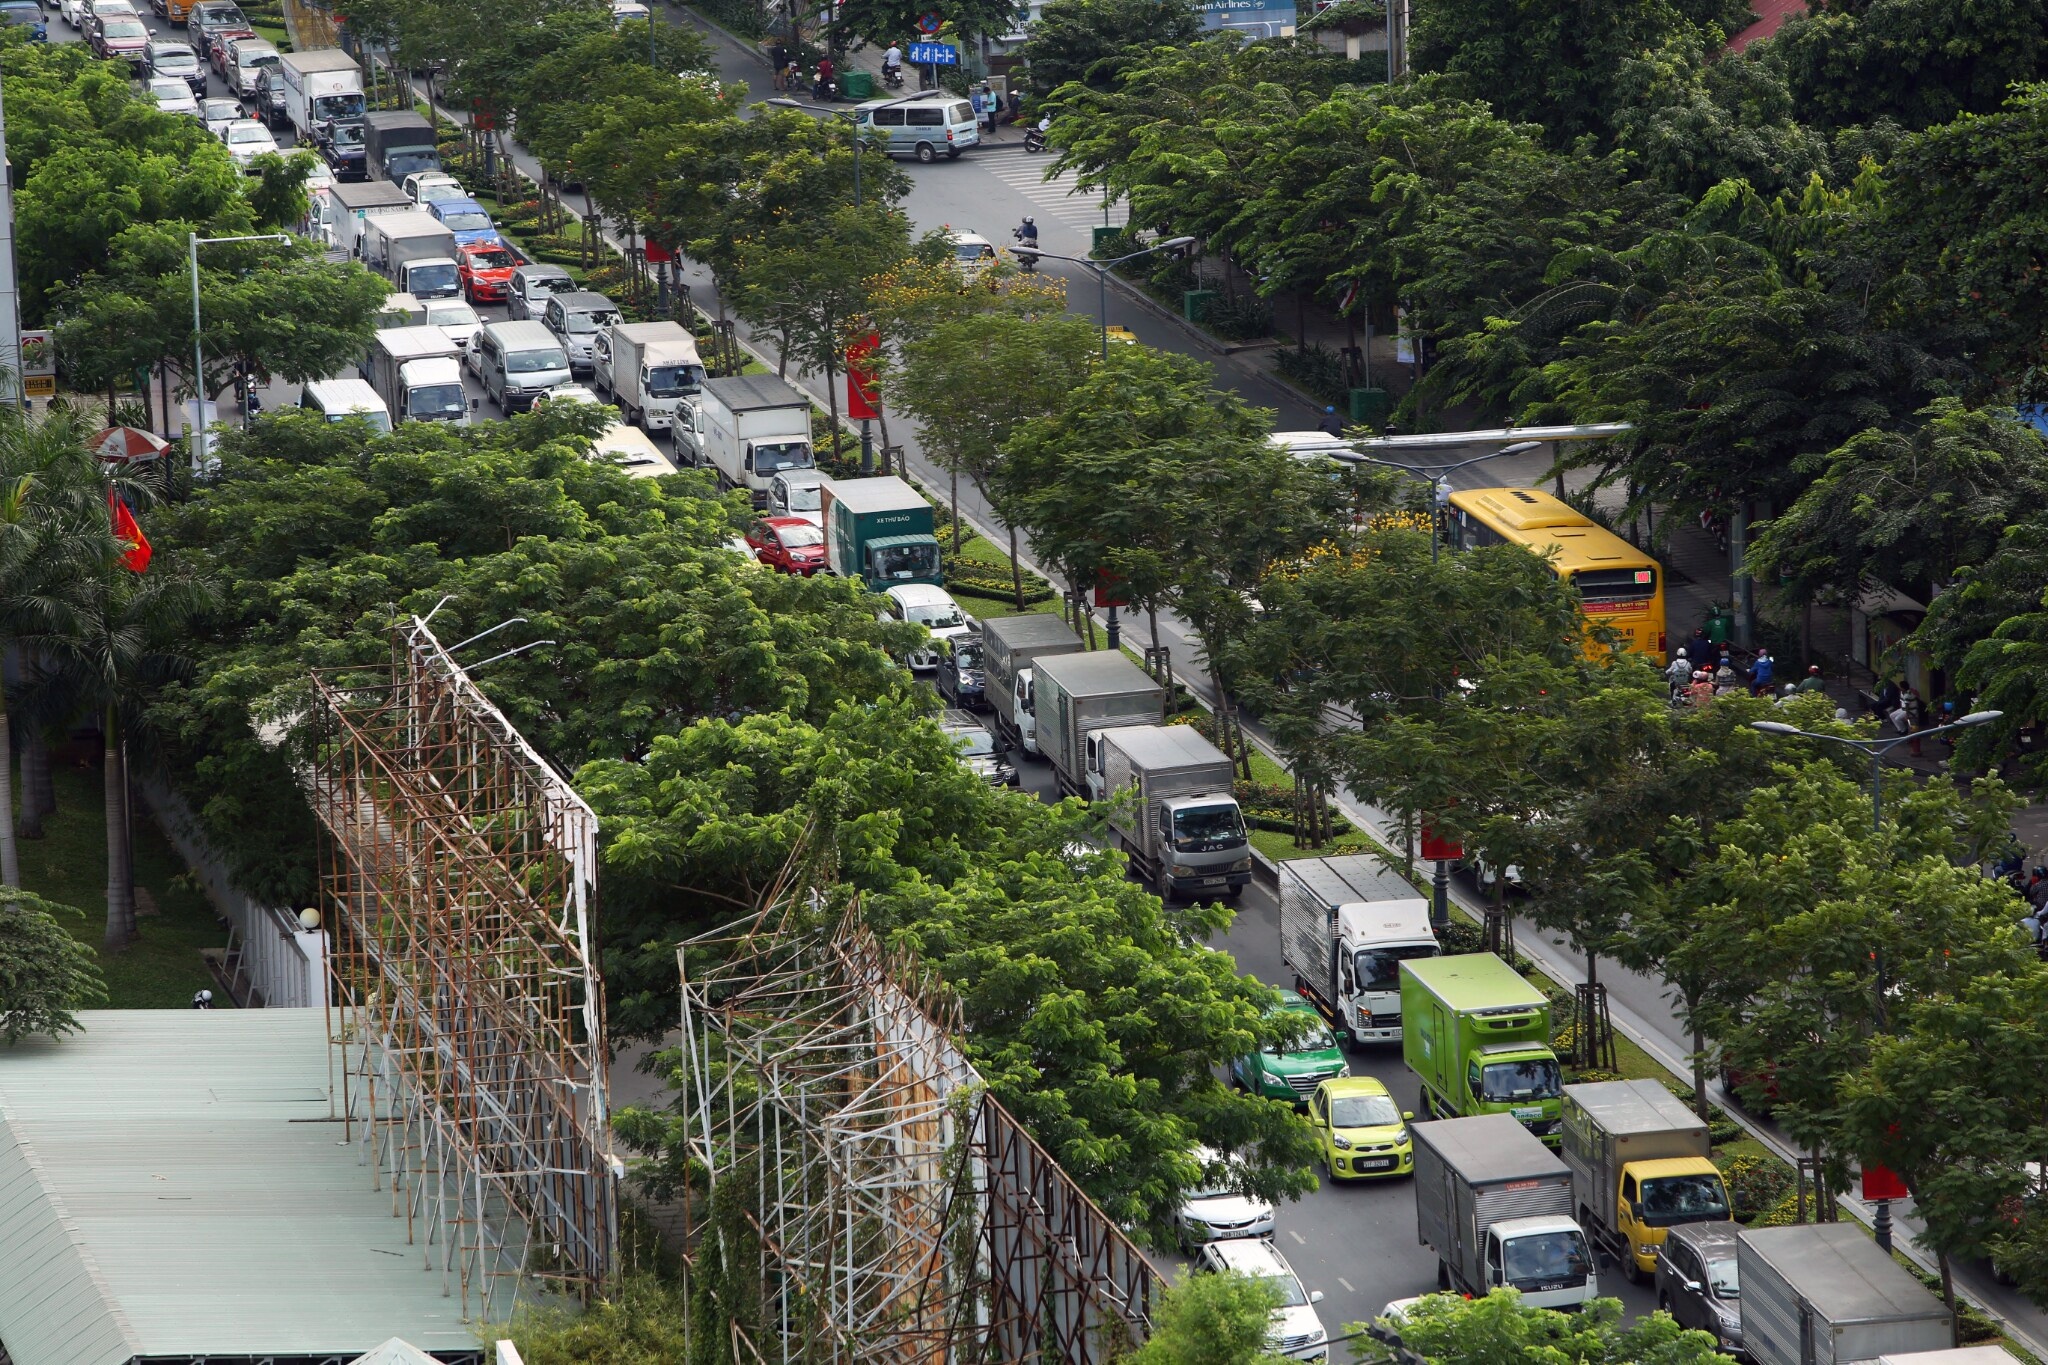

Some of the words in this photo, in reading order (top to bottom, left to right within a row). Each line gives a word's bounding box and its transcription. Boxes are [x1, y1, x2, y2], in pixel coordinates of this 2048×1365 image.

[1214, 0, 1251, 9] Airlines
[1200, 844, 1224, 852] JAC
[1540, 1283, 1563, 1291] ISUZU
